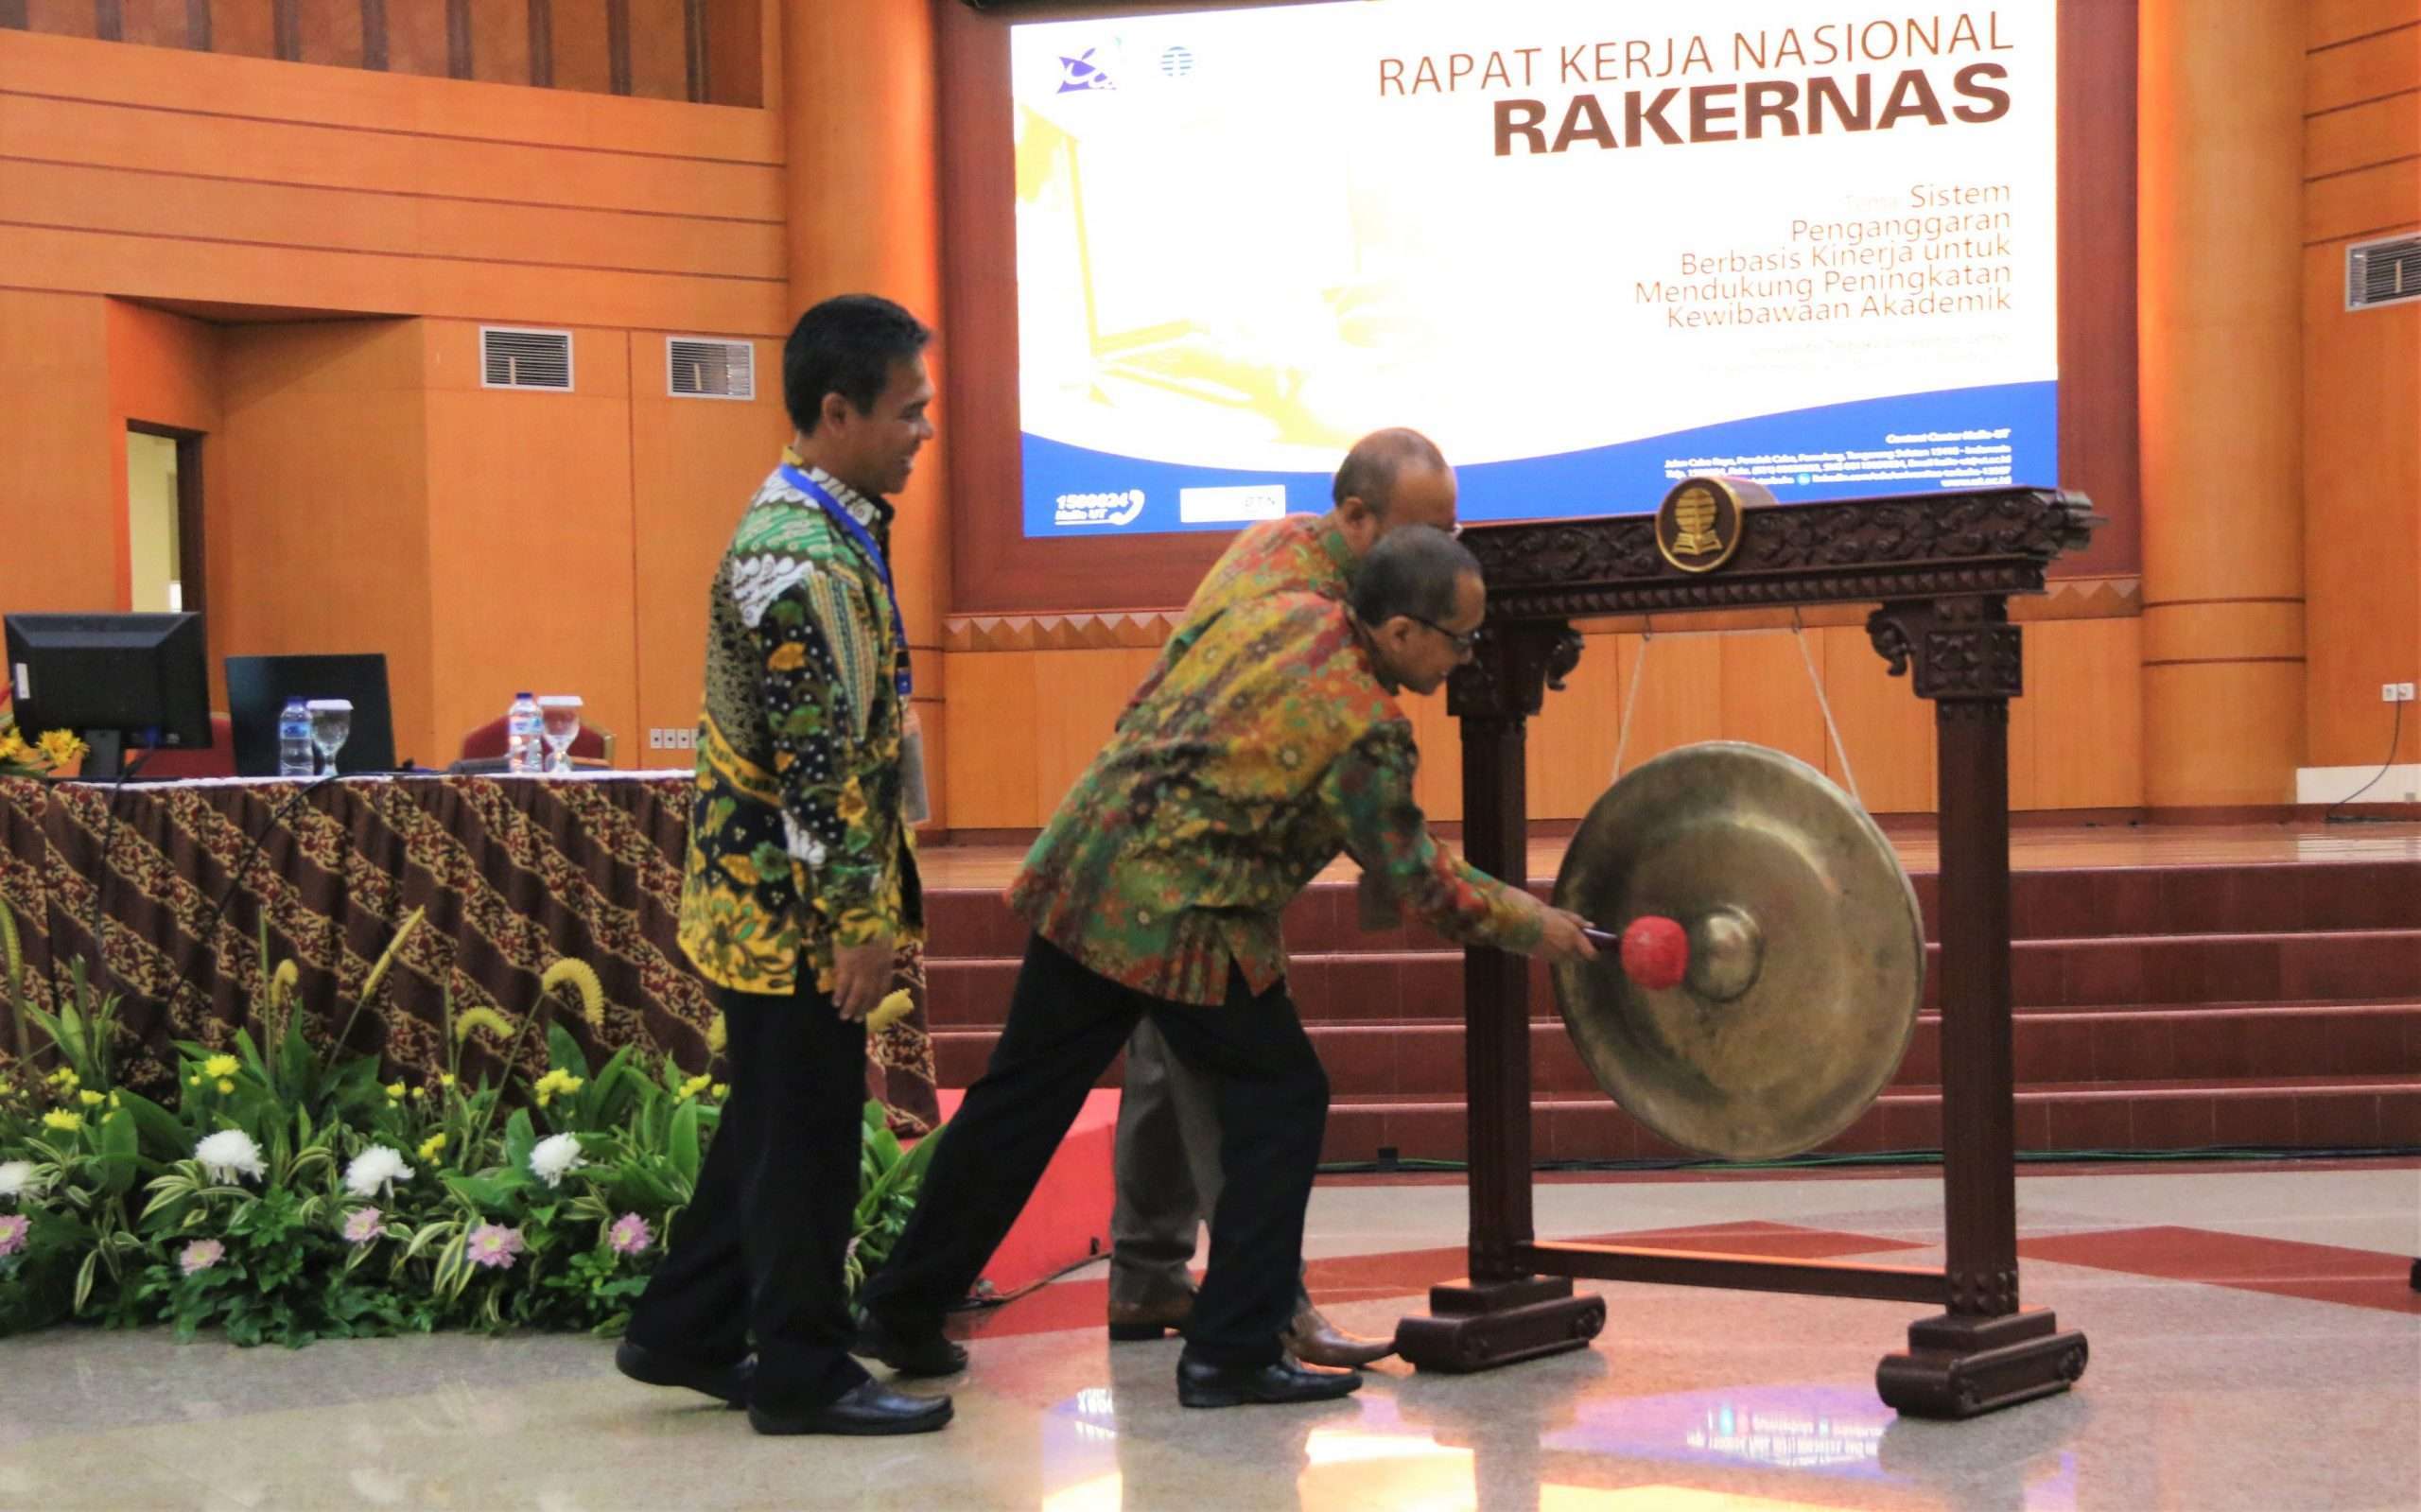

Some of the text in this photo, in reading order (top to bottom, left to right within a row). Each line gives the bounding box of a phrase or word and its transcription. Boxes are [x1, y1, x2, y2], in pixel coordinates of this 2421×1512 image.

[1378, 10, 2014, 96] RAPAT KERJA NASIONAL
[1493, 61, 2011, 157] RAKERNAS
[1909, 183, 2012, 209] Sistem
[1791, 211, 2012, 246] Penganggaran
[1681, 234, 2012, 275] Berbasis Kinerja untuk
[1635, 263, 2012, 304] Mendukung Peningkatan
[1667, 287, 2012, 329] Kewibawaan Akademik
